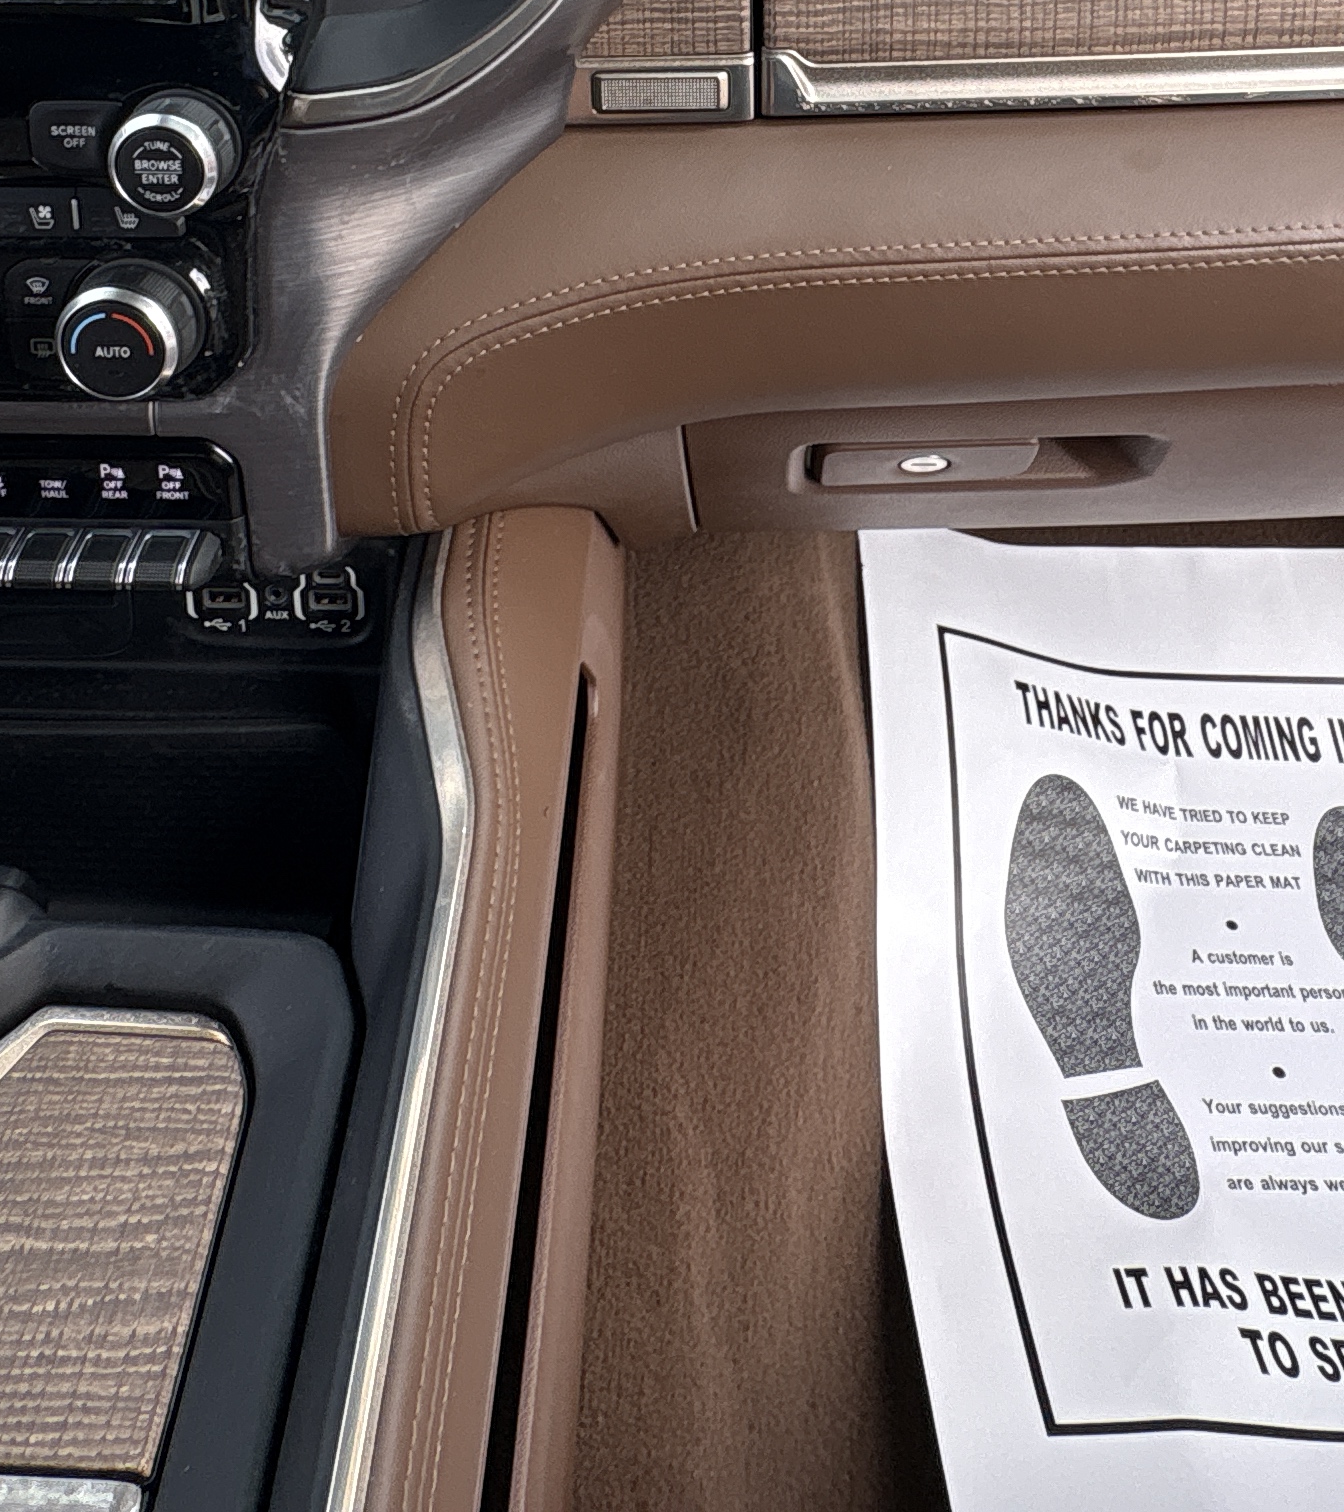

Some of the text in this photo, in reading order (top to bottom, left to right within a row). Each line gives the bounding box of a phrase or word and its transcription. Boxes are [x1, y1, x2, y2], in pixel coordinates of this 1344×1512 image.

[50, 124, 96, 137] SCREEN
[63, 137, 87, 149] OFF
[143, 141, 171, 152] TUNE
[134, 159, 182, 172] BROWSE
[141, 173, 179, 185] ENTER
[143, 190, 181, 203] SCROLL
[24, 295, 54, 306] FRONT
[95, 346, 131, 360] AUTO
[39, 480, 67, 489] TOW/
[104, 481, 124, 490] OFF
[161, 481, 182, 490] OFF
[41, 490, 69, 499] HAUL
[102, 490, 129, 499] REAR
[156, 491, 189, 500] FRONT
[264, 610, 290, 620] AUX
[238, 619, 247, 632] 1
[340, 619, 351, 633] 2
[1013, 680, 1126, 747] THANKS
[1129, 709, 1194, 757] FOR
[1199, 712, 1322, 765] COMING
[1116, 794, 1290, 826] WE HAVE TRIED TO KEEP
[1120, 829, 1302, 858] YOUR CARPETING CLEAN
[1134, 868, 1302, 891] WITH THIS PAPER MAT
[1191, 949, 1293, 967] A customer is
[1153, 980, 1178, 996] the
[1182, 982, 1222, 998] most
[1224, 981, 1296, 1003] important
[1193, 1014, 1335, 1034] in the world to us.
[1202, 1098, 1242, 1115] Your
[1210, 1136, 1297, 1157] improving
[1300, 1141, 1329, 1154] our
[1226, 1177, 1254, 1191] are
[1260, 1175, 1319, 1195] always
[1112, 1266, 1151, 1309] IT
[1163, 1265, 1250, 1312] HAS
[1237, 1326, 1300, 1379] TO
